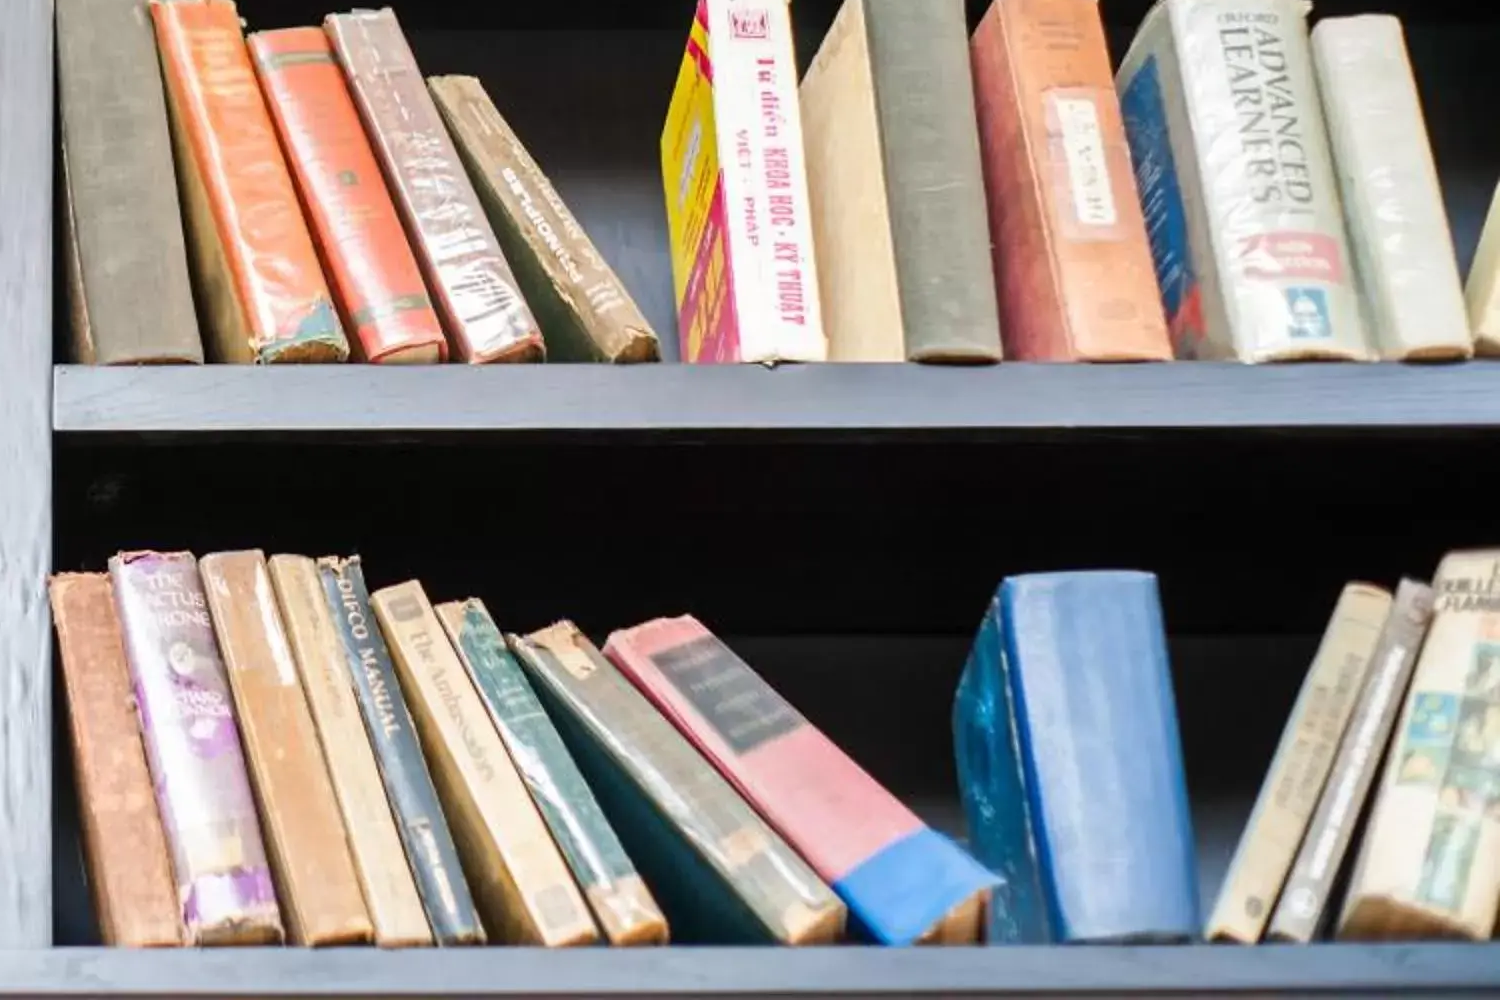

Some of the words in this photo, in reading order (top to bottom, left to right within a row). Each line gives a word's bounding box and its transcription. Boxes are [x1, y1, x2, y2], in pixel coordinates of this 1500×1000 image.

[764, 148, 792, 190] KHOA
[1252, 28, 1314, 205] ADVANCED
[337, 578, 367, 640] DIFCO
[359, 644, 402, 737] MANUAL
[409, 630, 437, 664] The
[432, 663, 496, 785] Ambassadors
